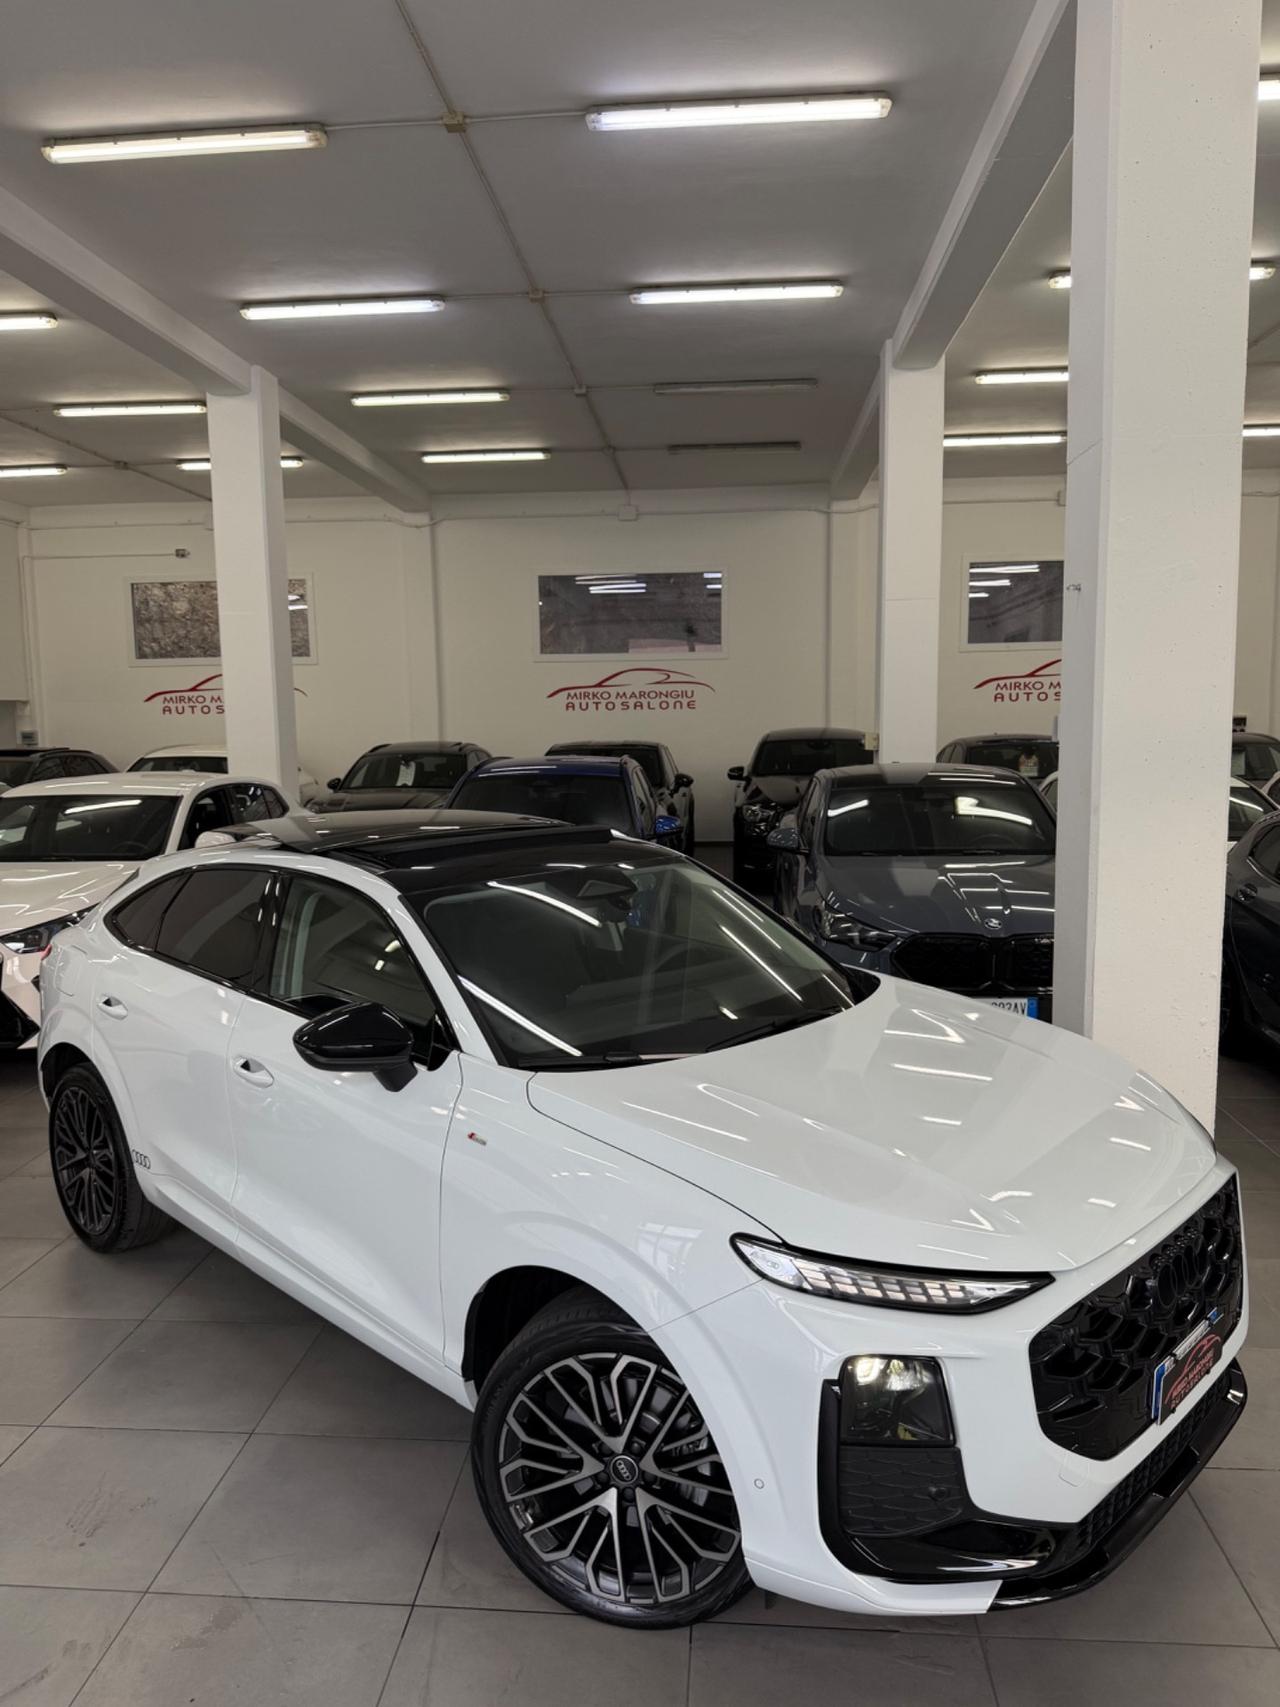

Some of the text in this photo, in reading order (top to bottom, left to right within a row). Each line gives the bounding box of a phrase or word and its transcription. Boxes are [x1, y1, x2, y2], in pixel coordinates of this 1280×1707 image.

[995, 681, 1044, 691] MIRKO
[162, 695, 207, 704] MIRKO
[566, 690, 695, 700] MIRKO MARONGIU
[993, 691, 1062, 702] AUTOS
[162, 705, 225, 715] AUTOS
[565, 700, 697, 711] AUTOSALONE
